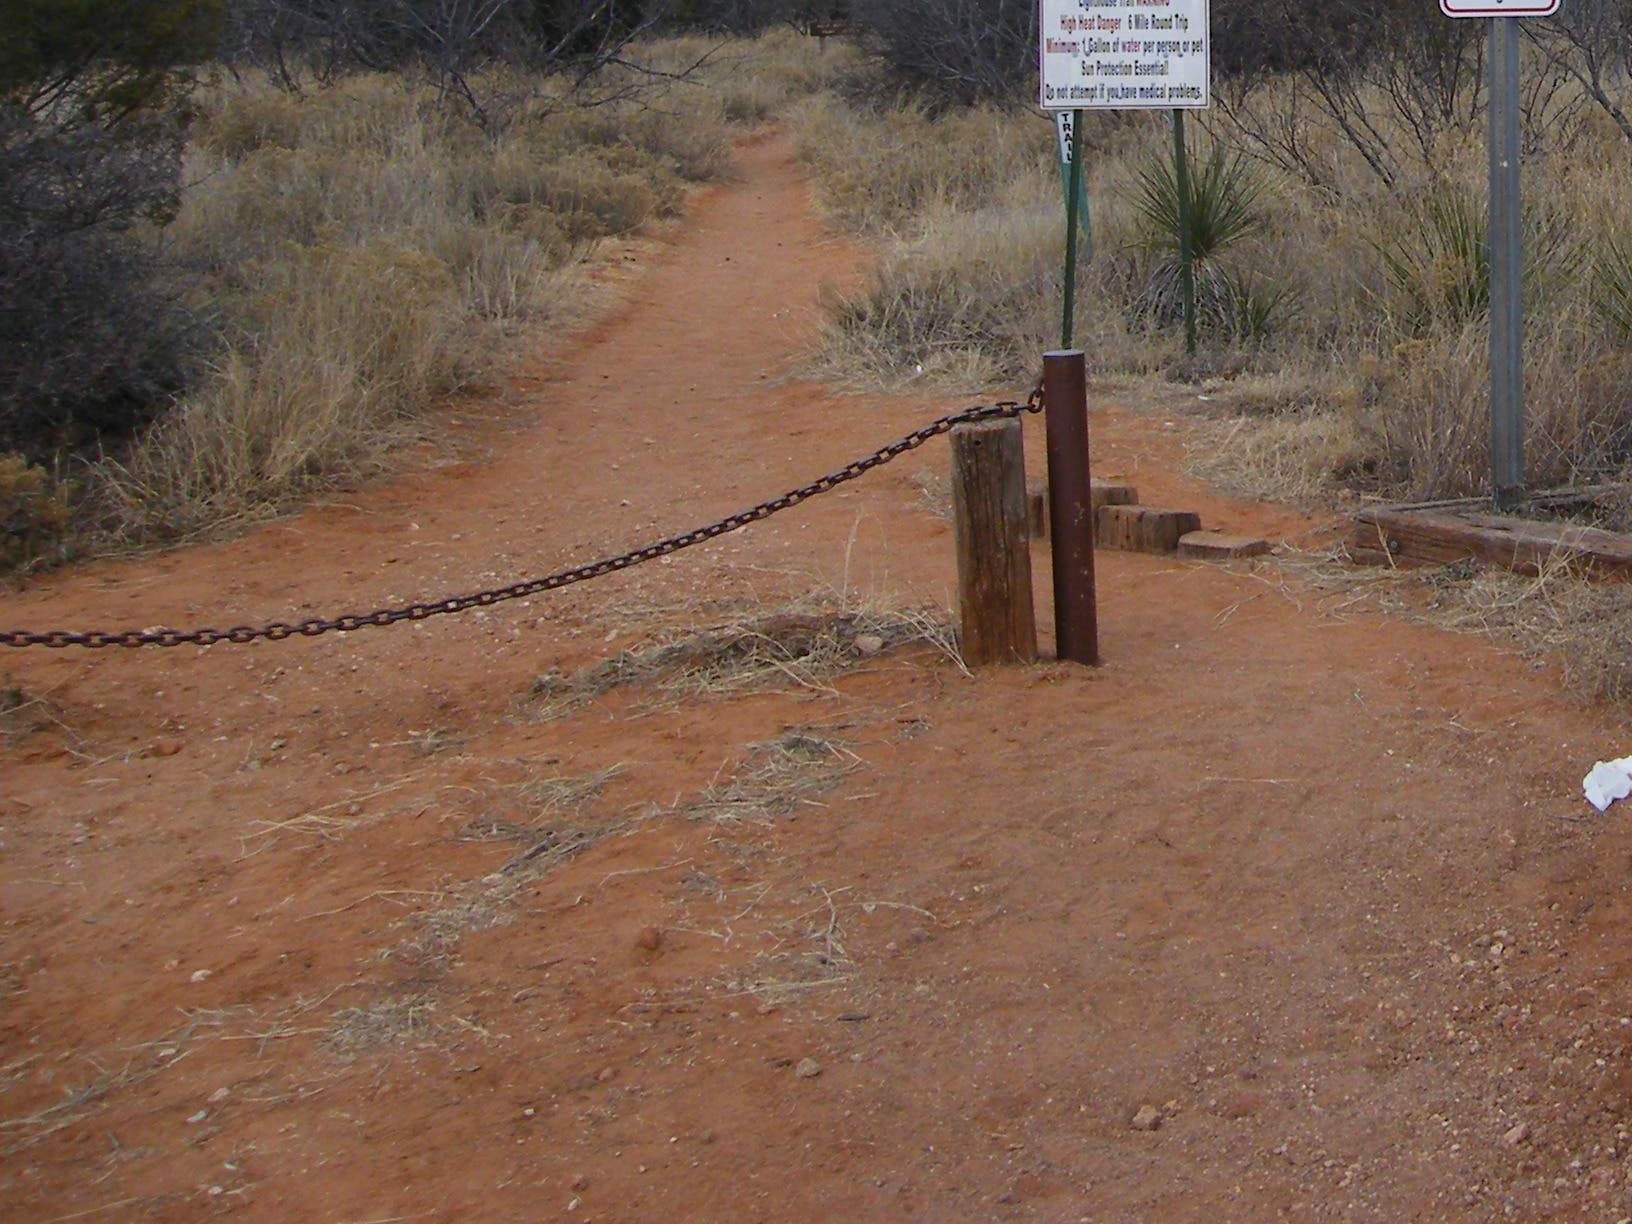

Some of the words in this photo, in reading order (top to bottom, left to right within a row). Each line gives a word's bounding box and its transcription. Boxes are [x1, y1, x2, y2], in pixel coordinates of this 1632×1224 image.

[1061, 14, 1077, 34] High
[1078, 14, 1095, 31] Heat
[1097, 14, 1121, 34] Danger
[1135, 14, 1149, 30] Mile
[1151, 13, 1173, 30] Round
[1175, 13, 1189, 34] Trip
[1088, 37, 1110, 53] Gallon
[1113, 37, 1119, 53] of
[1121, 38, 1141, 53] water
[1143, 40, 1154, 56] per
[1156, 40, 1180, 56] person
[1182, 40, 1190, 53] or
[1191, 37, 1203, 56] pet
[1082, 60, 1095, 76] Sun
[1097, 60, 1132, 76] Protection
[1046, 83, 1055, 100] Do
[1056, 83, 1068, 99] not
[1070, 83, 1098, 103] attempt
[1100, 83, 1105, 99] if
[1106, 85, 1120, 103] you
[1121, 82, 1137, 99] have
[1139, 82, 1167, 99] medical
[1061, 113, 1073, 161] TRAIL
